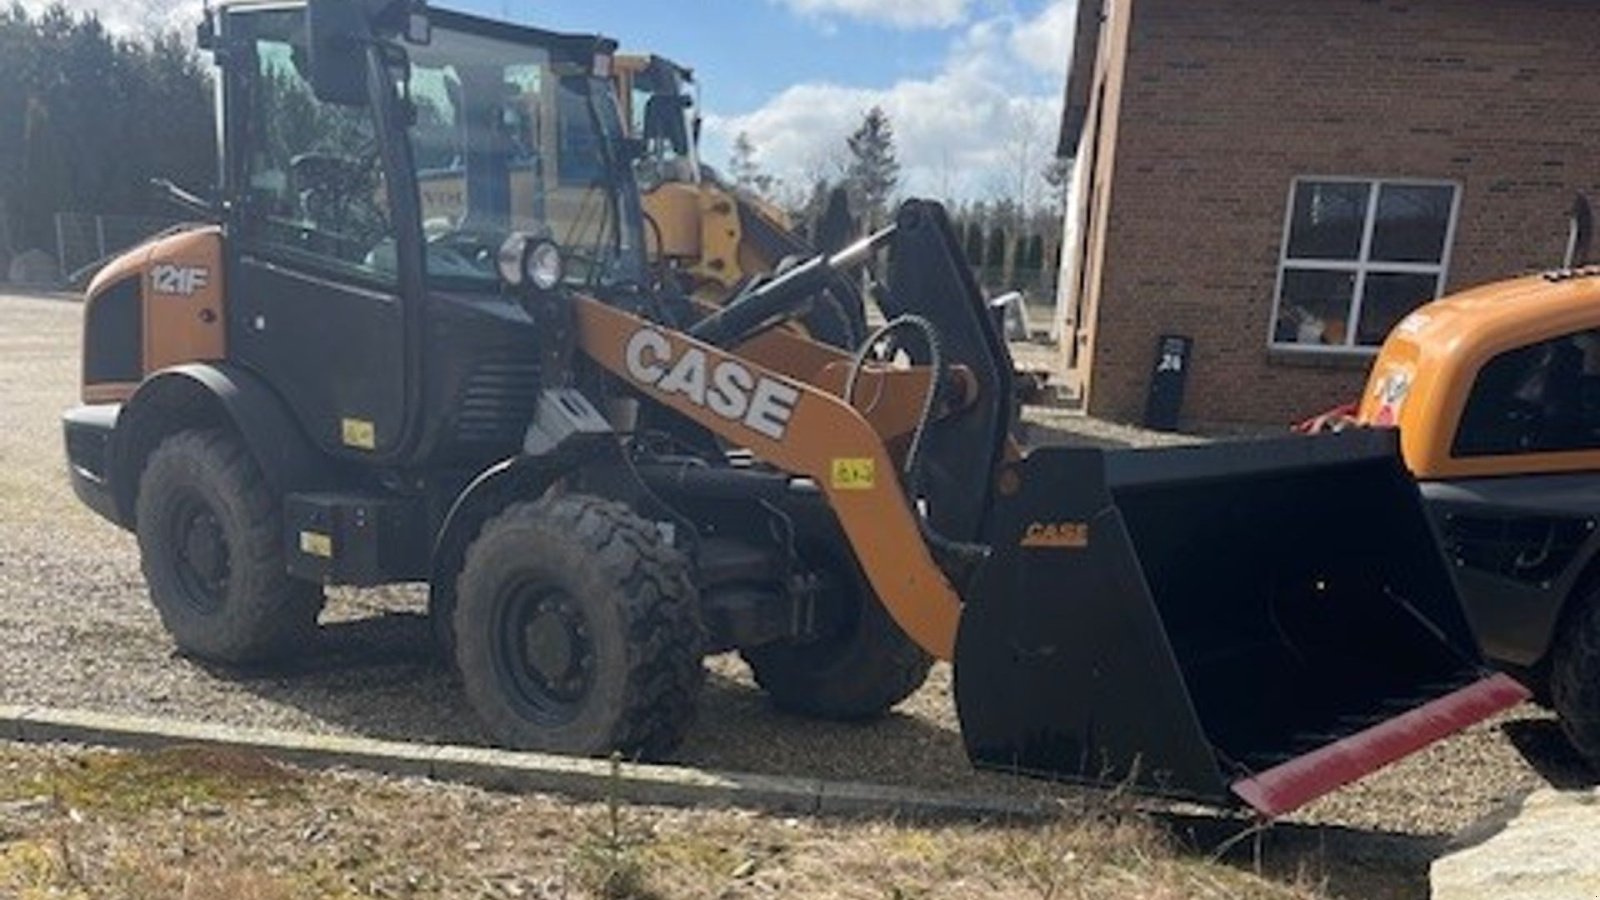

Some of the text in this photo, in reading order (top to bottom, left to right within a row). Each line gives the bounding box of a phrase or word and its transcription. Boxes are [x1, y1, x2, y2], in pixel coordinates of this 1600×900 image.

[150, 264, 208, 295] 121F
[626, 327, 799, 439] CASE
[1023, 521, 1088, 541] CASE
